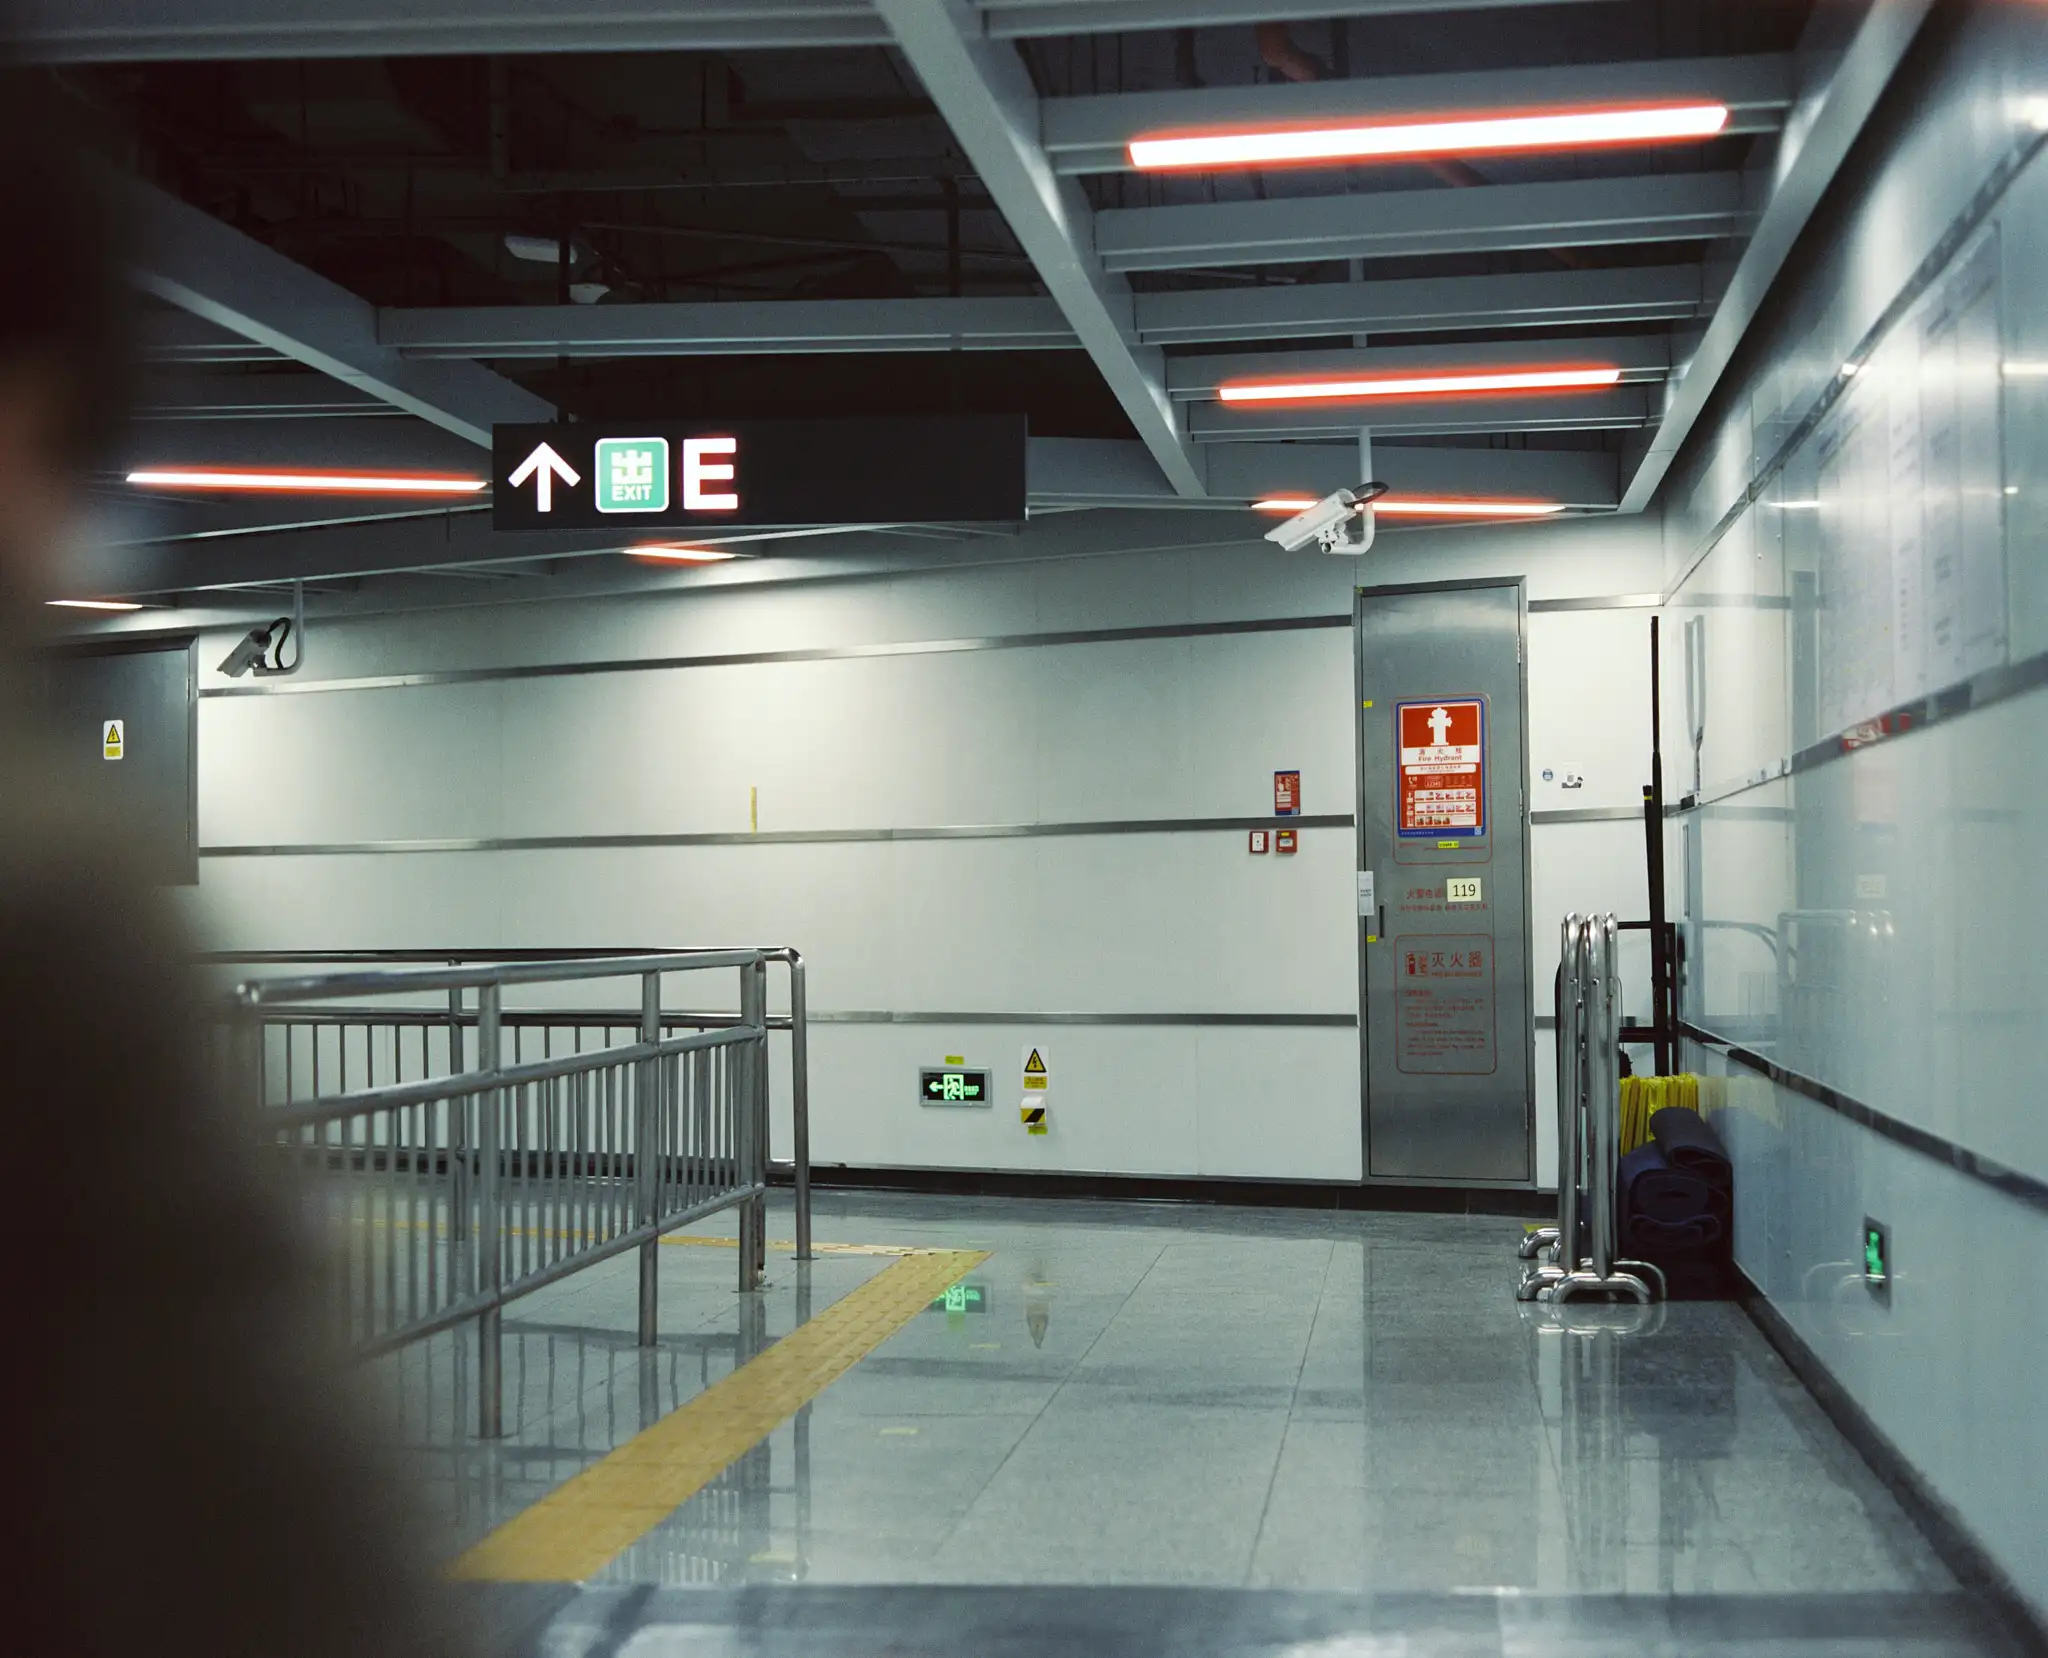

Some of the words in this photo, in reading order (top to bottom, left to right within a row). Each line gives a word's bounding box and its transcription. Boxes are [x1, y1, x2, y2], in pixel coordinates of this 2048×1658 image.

[683, 437, 738, 510] E
[611, 485, 653, 502] EXIT
[1434, 754, 1463, 762] Hydrant
[1453, 883, 1476, 897] 119
[1431, 950, 1483, 968] 灭火器
